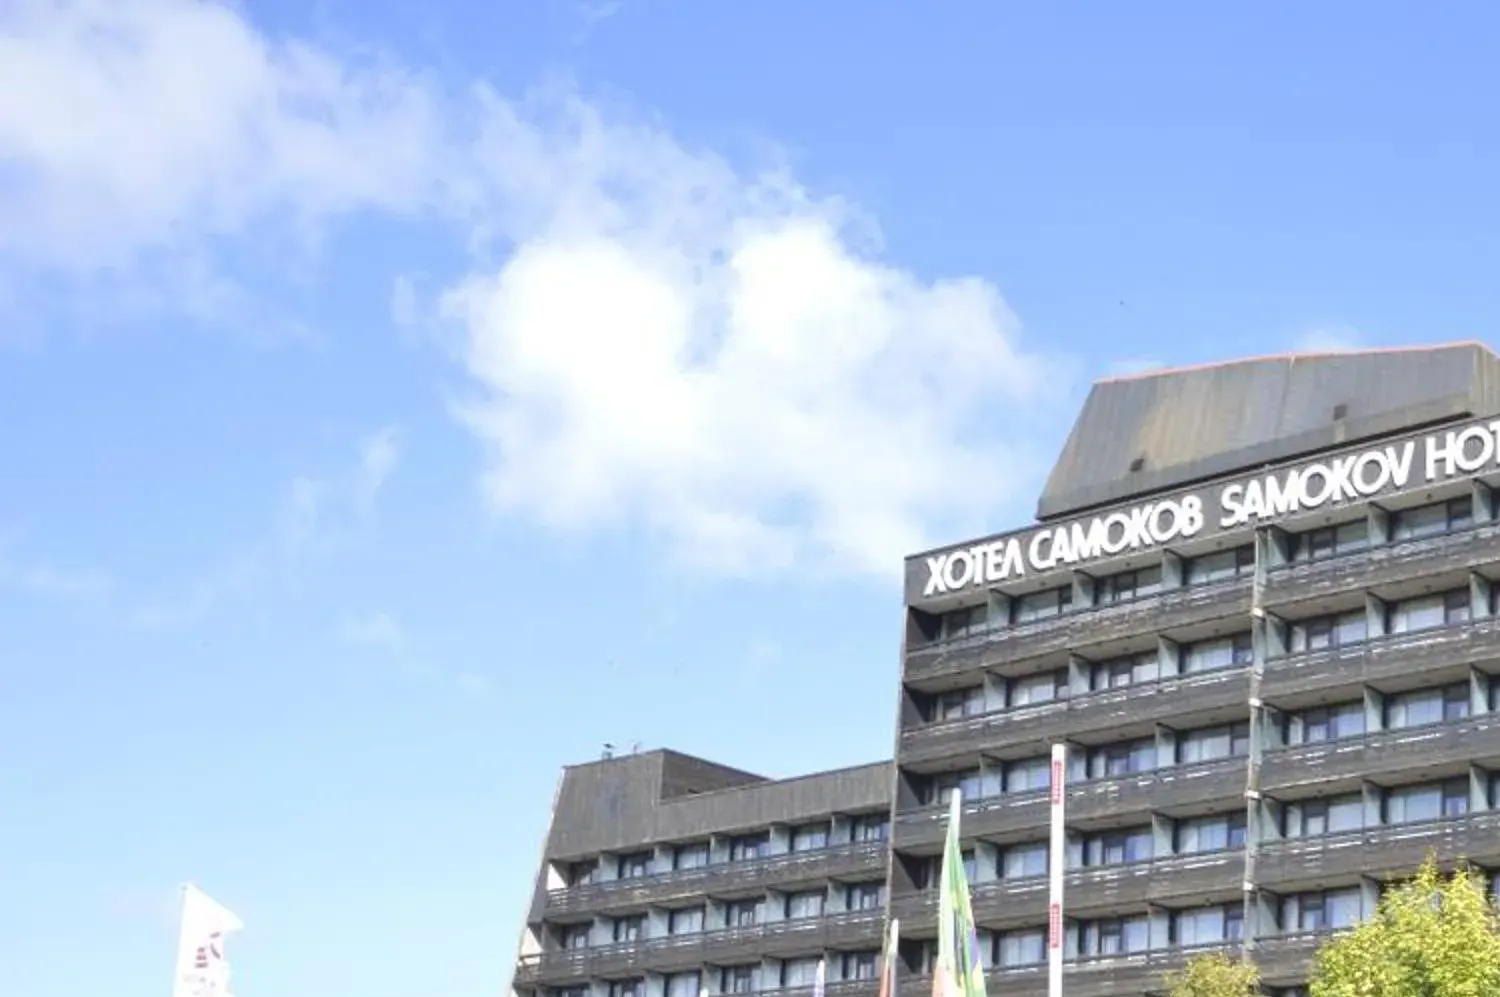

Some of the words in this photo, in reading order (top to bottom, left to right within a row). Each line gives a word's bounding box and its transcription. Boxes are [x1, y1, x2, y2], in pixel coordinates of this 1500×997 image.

[1220, 441, 1415, 527] SAMOKOV
[923, 538, 1025, 596] ХОТЕЛ
[1029, 495, 1204, 571] САМОКОВ
